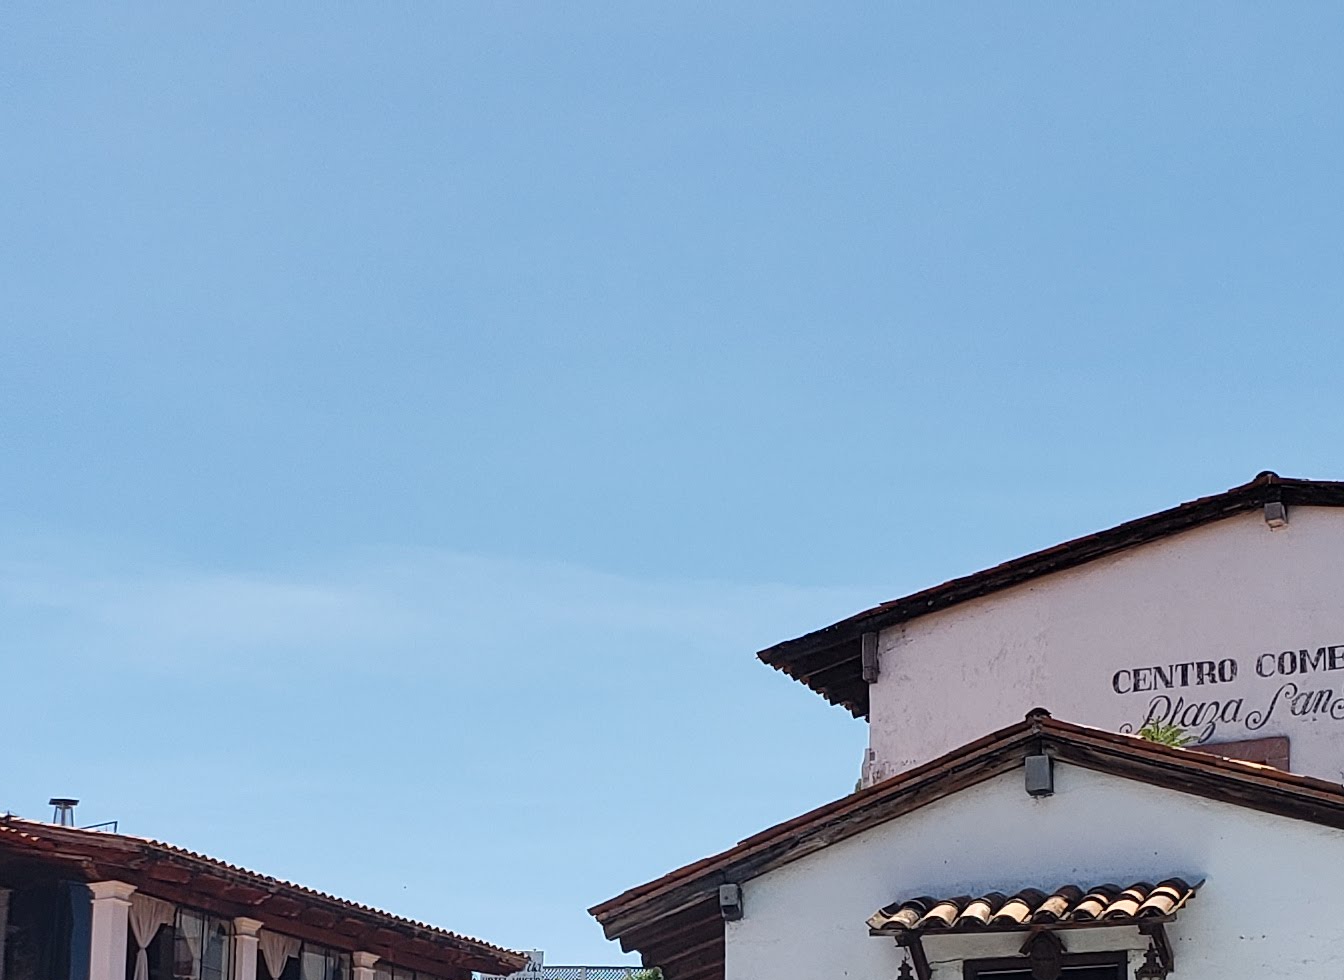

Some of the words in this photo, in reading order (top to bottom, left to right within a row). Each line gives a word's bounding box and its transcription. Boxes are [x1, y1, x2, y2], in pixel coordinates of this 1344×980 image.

[1113, 658, 1237, 694] CENTRO
[1120, 696, 1244, 744] Plaza
[1245, 682, 1333, 730] San
